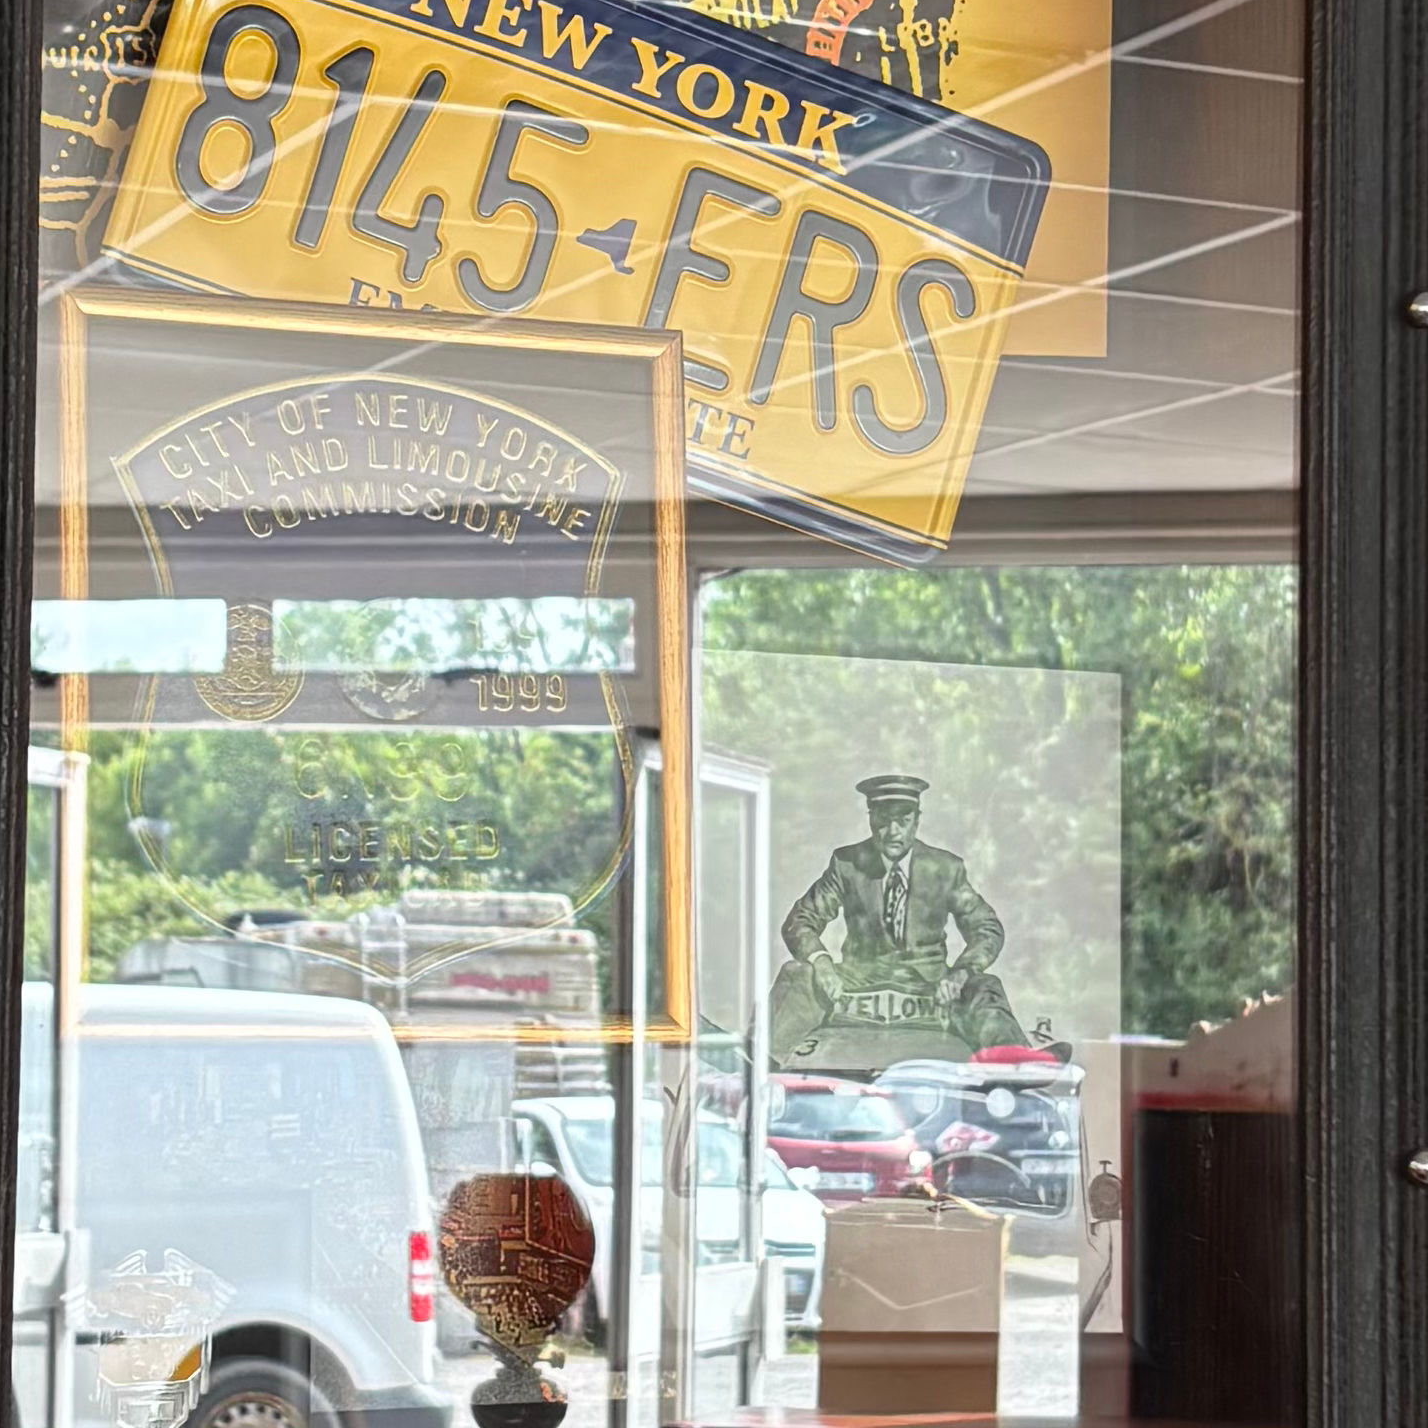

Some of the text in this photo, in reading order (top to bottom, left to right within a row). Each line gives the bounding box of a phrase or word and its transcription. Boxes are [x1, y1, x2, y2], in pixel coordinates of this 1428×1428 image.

[630, 36, 858, 176] YORK
[173, 4, 590, 313] 8145
[159, 391, 589, 493] CITY OF NEW YORK
[160, 436, 592, 541] TAXI AND LIMOUSINE
[242, 481, 522, 545] COMMISSION
[469, 673, 568, 713] 1999
[283, 823, 501, 863] LICENSED
[839, 993, 936, 1022] YELLOW
